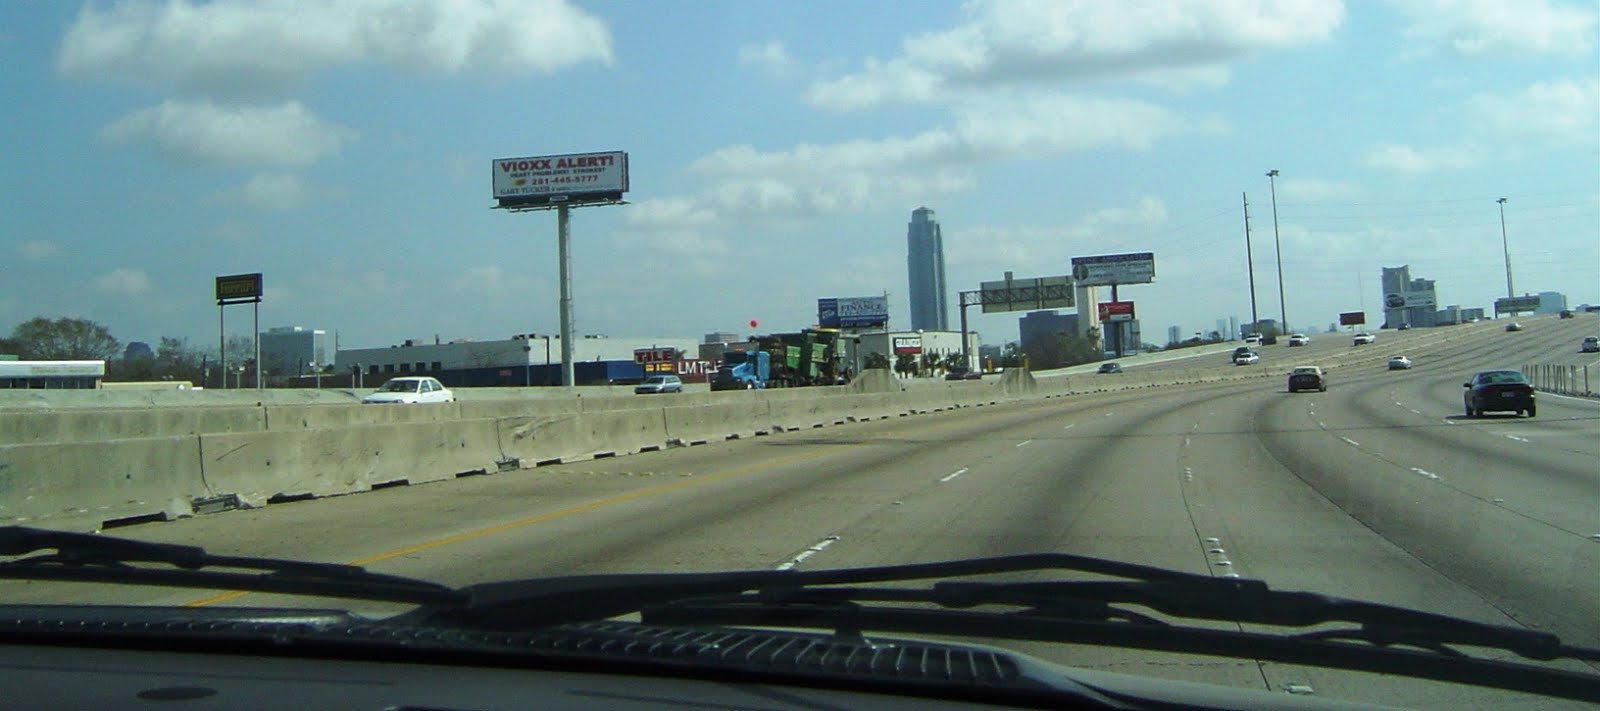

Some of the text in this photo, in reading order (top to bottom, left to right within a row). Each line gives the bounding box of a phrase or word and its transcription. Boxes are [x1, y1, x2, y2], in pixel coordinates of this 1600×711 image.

[501, 156, 614, 172] VIOXX ALERT!
[634, 351, 672, 361] TILE
